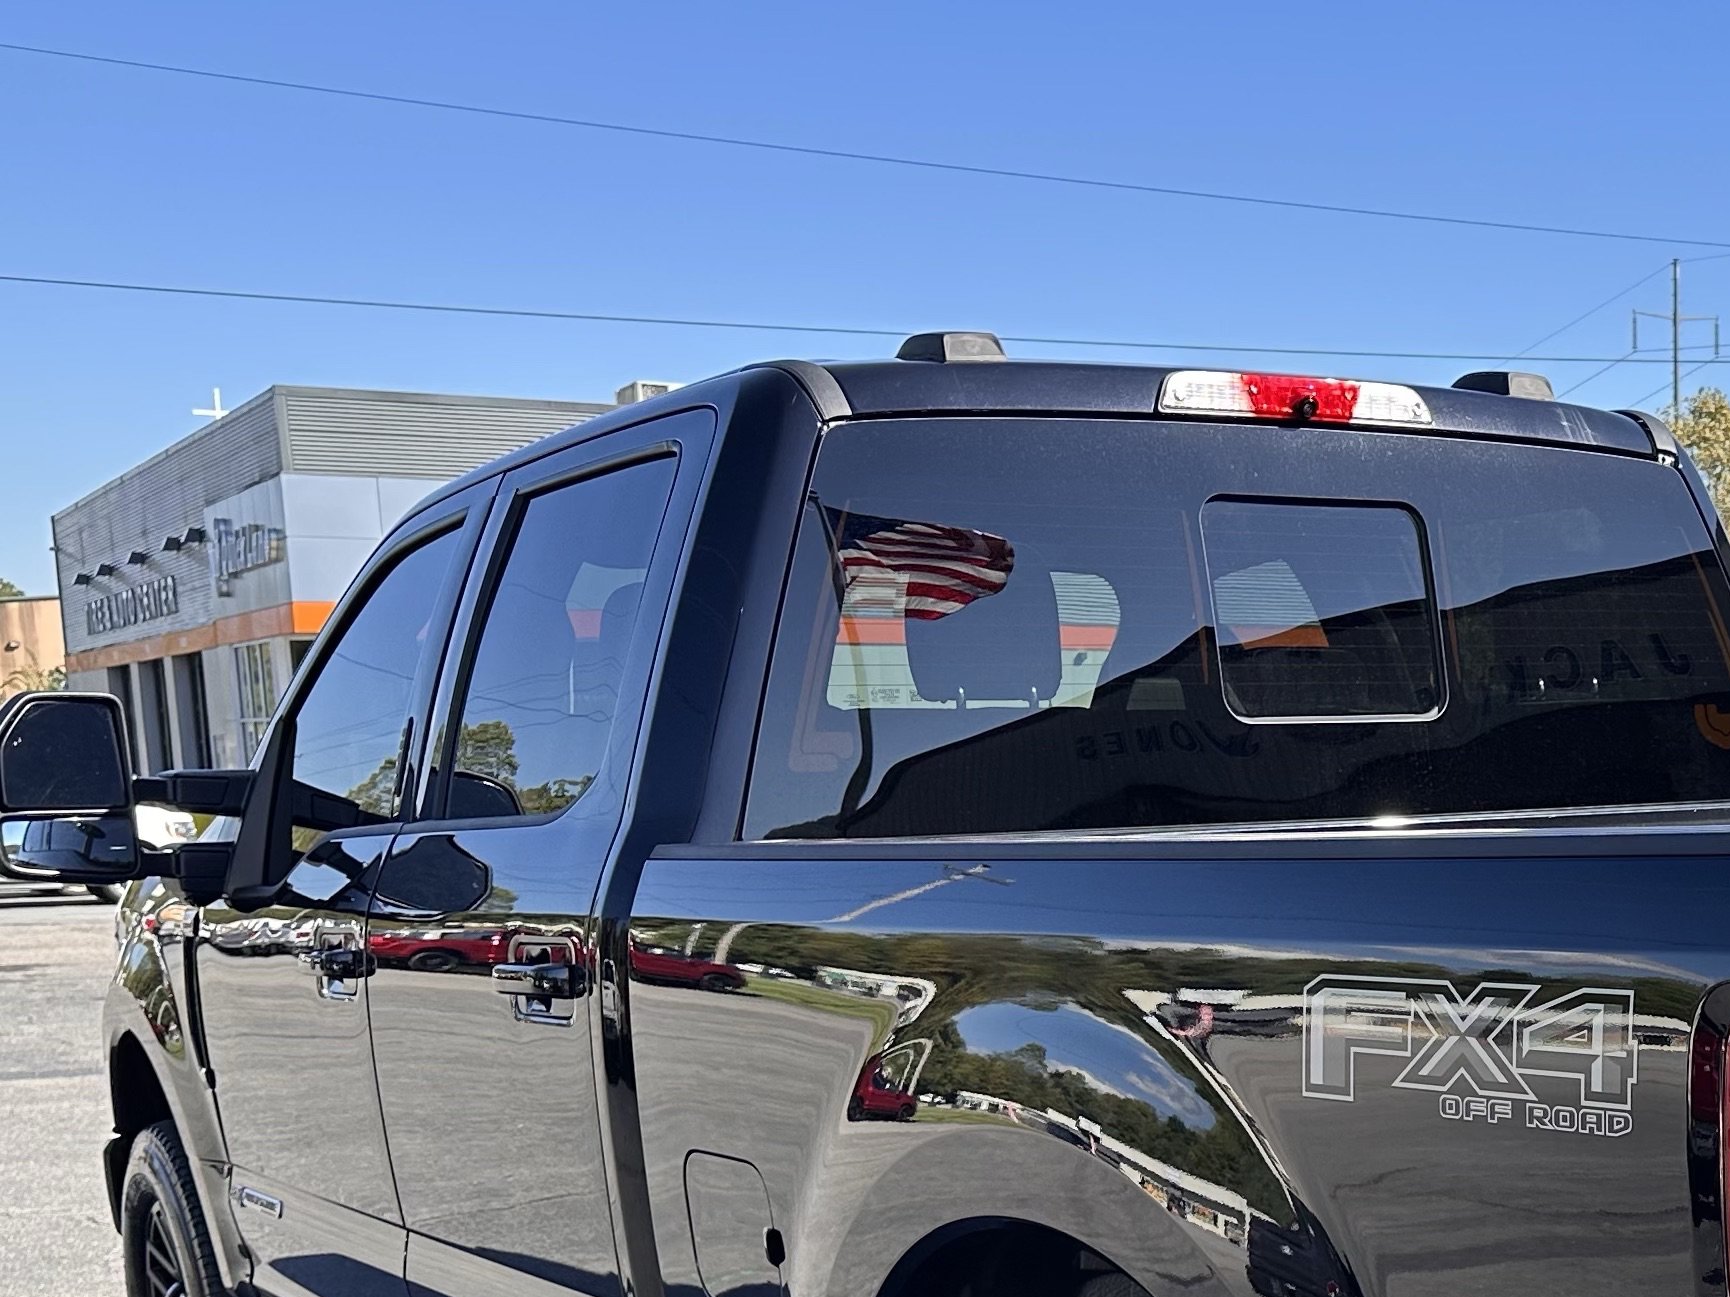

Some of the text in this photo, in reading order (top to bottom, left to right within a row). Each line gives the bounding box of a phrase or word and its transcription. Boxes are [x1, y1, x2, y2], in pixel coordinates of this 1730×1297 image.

[1303, 973, 1639, 1110] FX4
[1439, 1094, 1633, 1137] OFF ROAD
